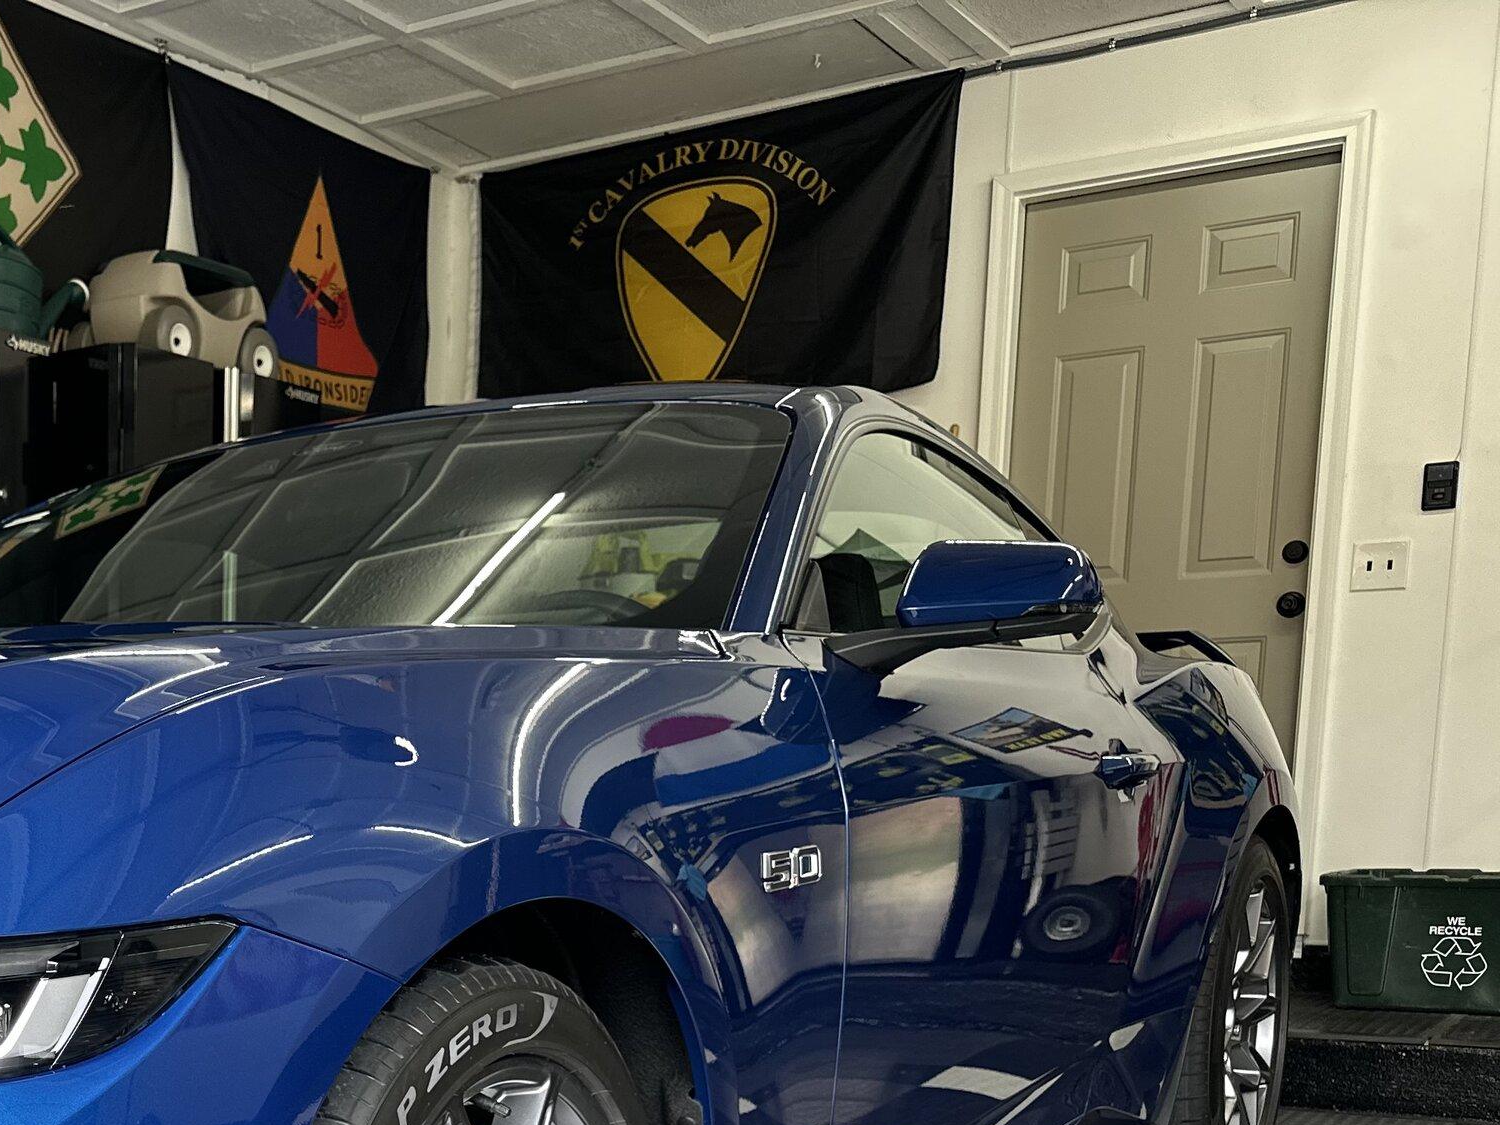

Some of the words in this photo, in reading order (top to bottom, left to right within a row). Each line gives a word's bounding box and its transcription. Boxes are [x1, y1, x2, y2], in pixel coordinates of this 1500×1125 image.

[588, 140, 716, 224] CAVALRY
[717, 138, 837, 206] DIVISION
[1429, 925, 1483, 936] RECYCLE
[1446, 916, 1466, 926] WE
[424, 1003, 518, 1093] ZERO
